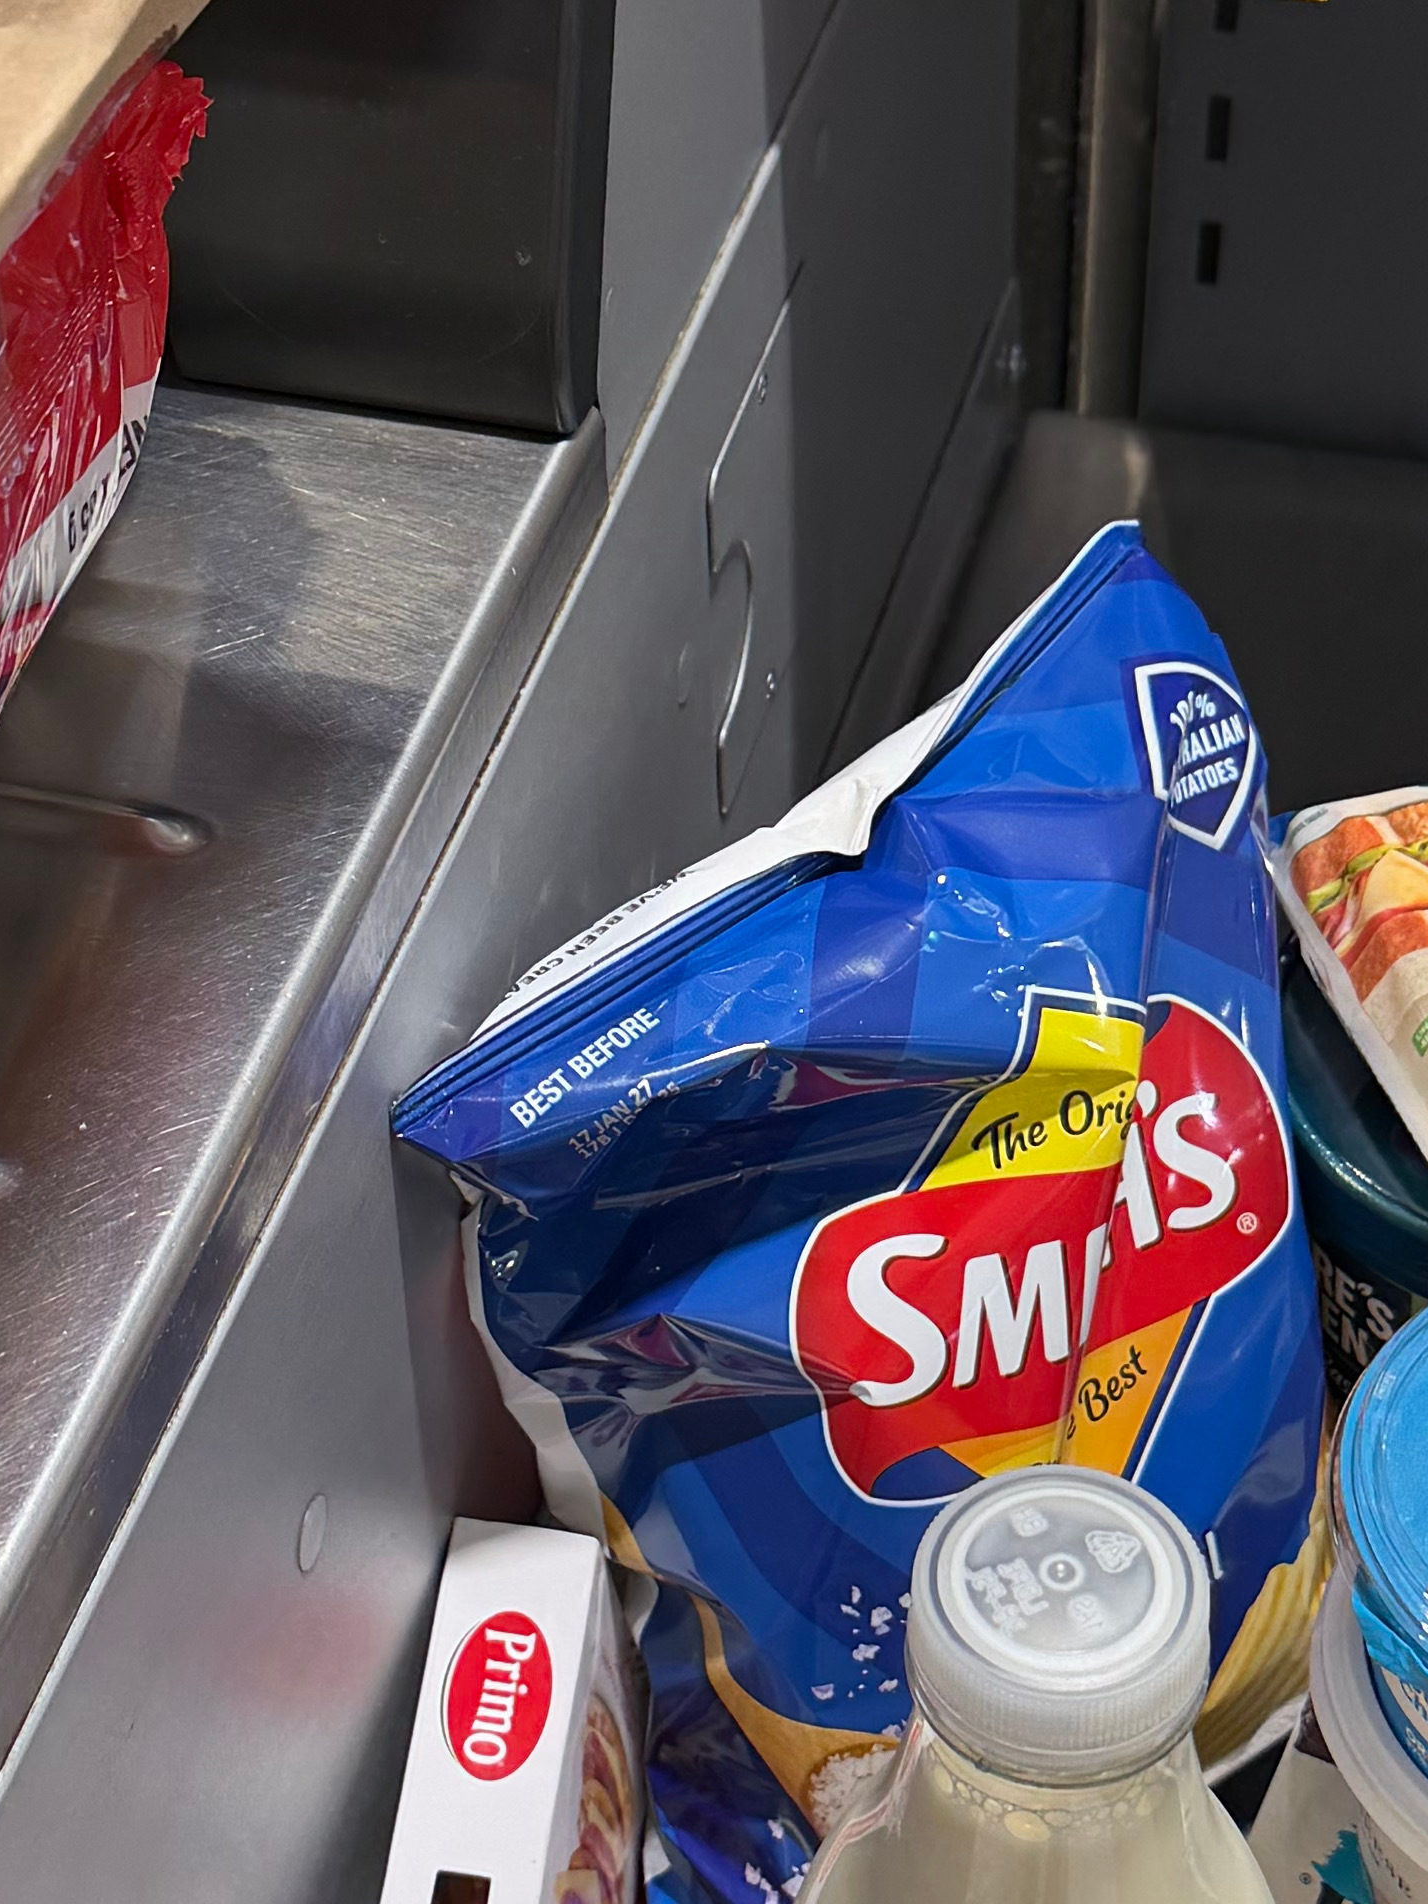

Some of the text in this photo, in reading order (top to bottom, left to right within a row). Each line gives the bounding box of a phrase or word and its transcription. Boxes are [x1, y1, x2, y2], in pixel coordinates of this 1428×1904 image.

[509, 1007, 661, 1128] BEST BEFORE
[971, 1117, 1048, 1171] The
[1077, 1345, 1151, 1425] Best
[462, 1628, 537, 1769] Primo
